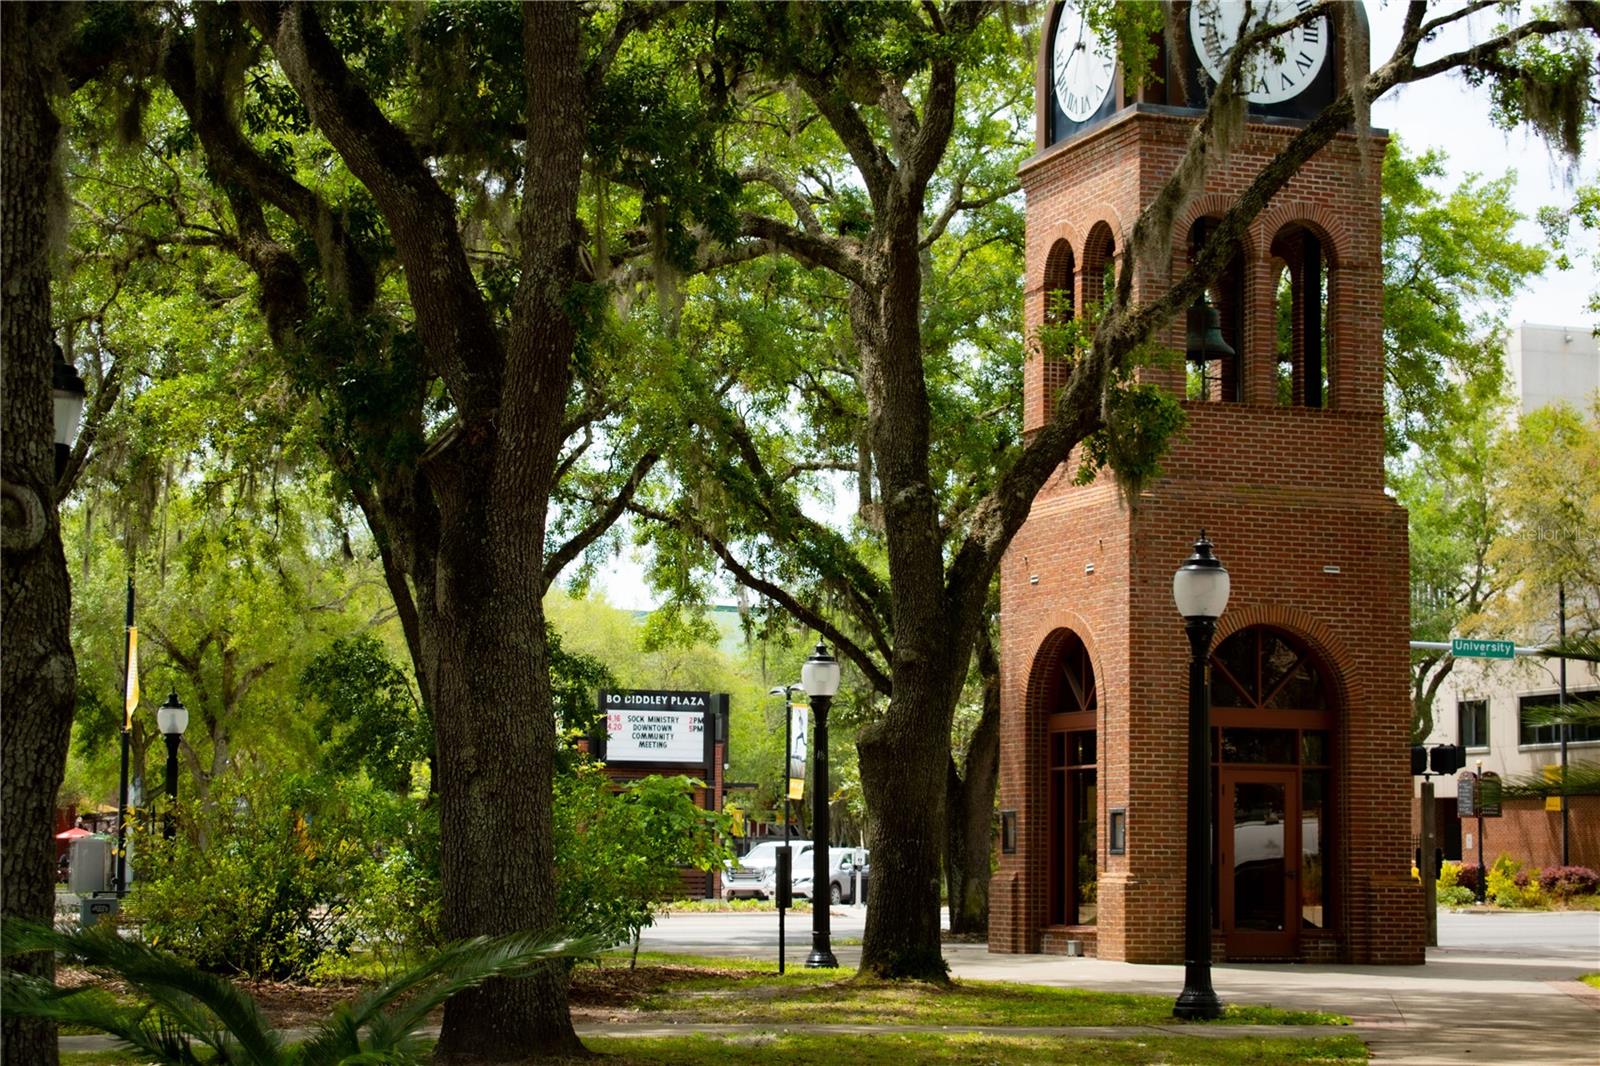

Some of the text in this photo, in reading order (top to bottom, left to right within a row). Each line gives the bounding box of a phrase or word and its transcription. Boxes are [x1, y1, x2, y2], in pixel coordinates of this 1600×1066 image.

[1281, 72, 1295, 91] V
[1455, 640, 1511, 655] University
[606, 694, 621, 704] BO
[671, 696, 705, 706] PLAZA
[627, 715, 645, 723] SOCK
[648, 716, 679, 724] MINISTRY
[633, 724, 672, 732] DOWNTOWN
[631, 732, 674, 741] COMMUNITY
[638, 741, 668, 749] MEETING
